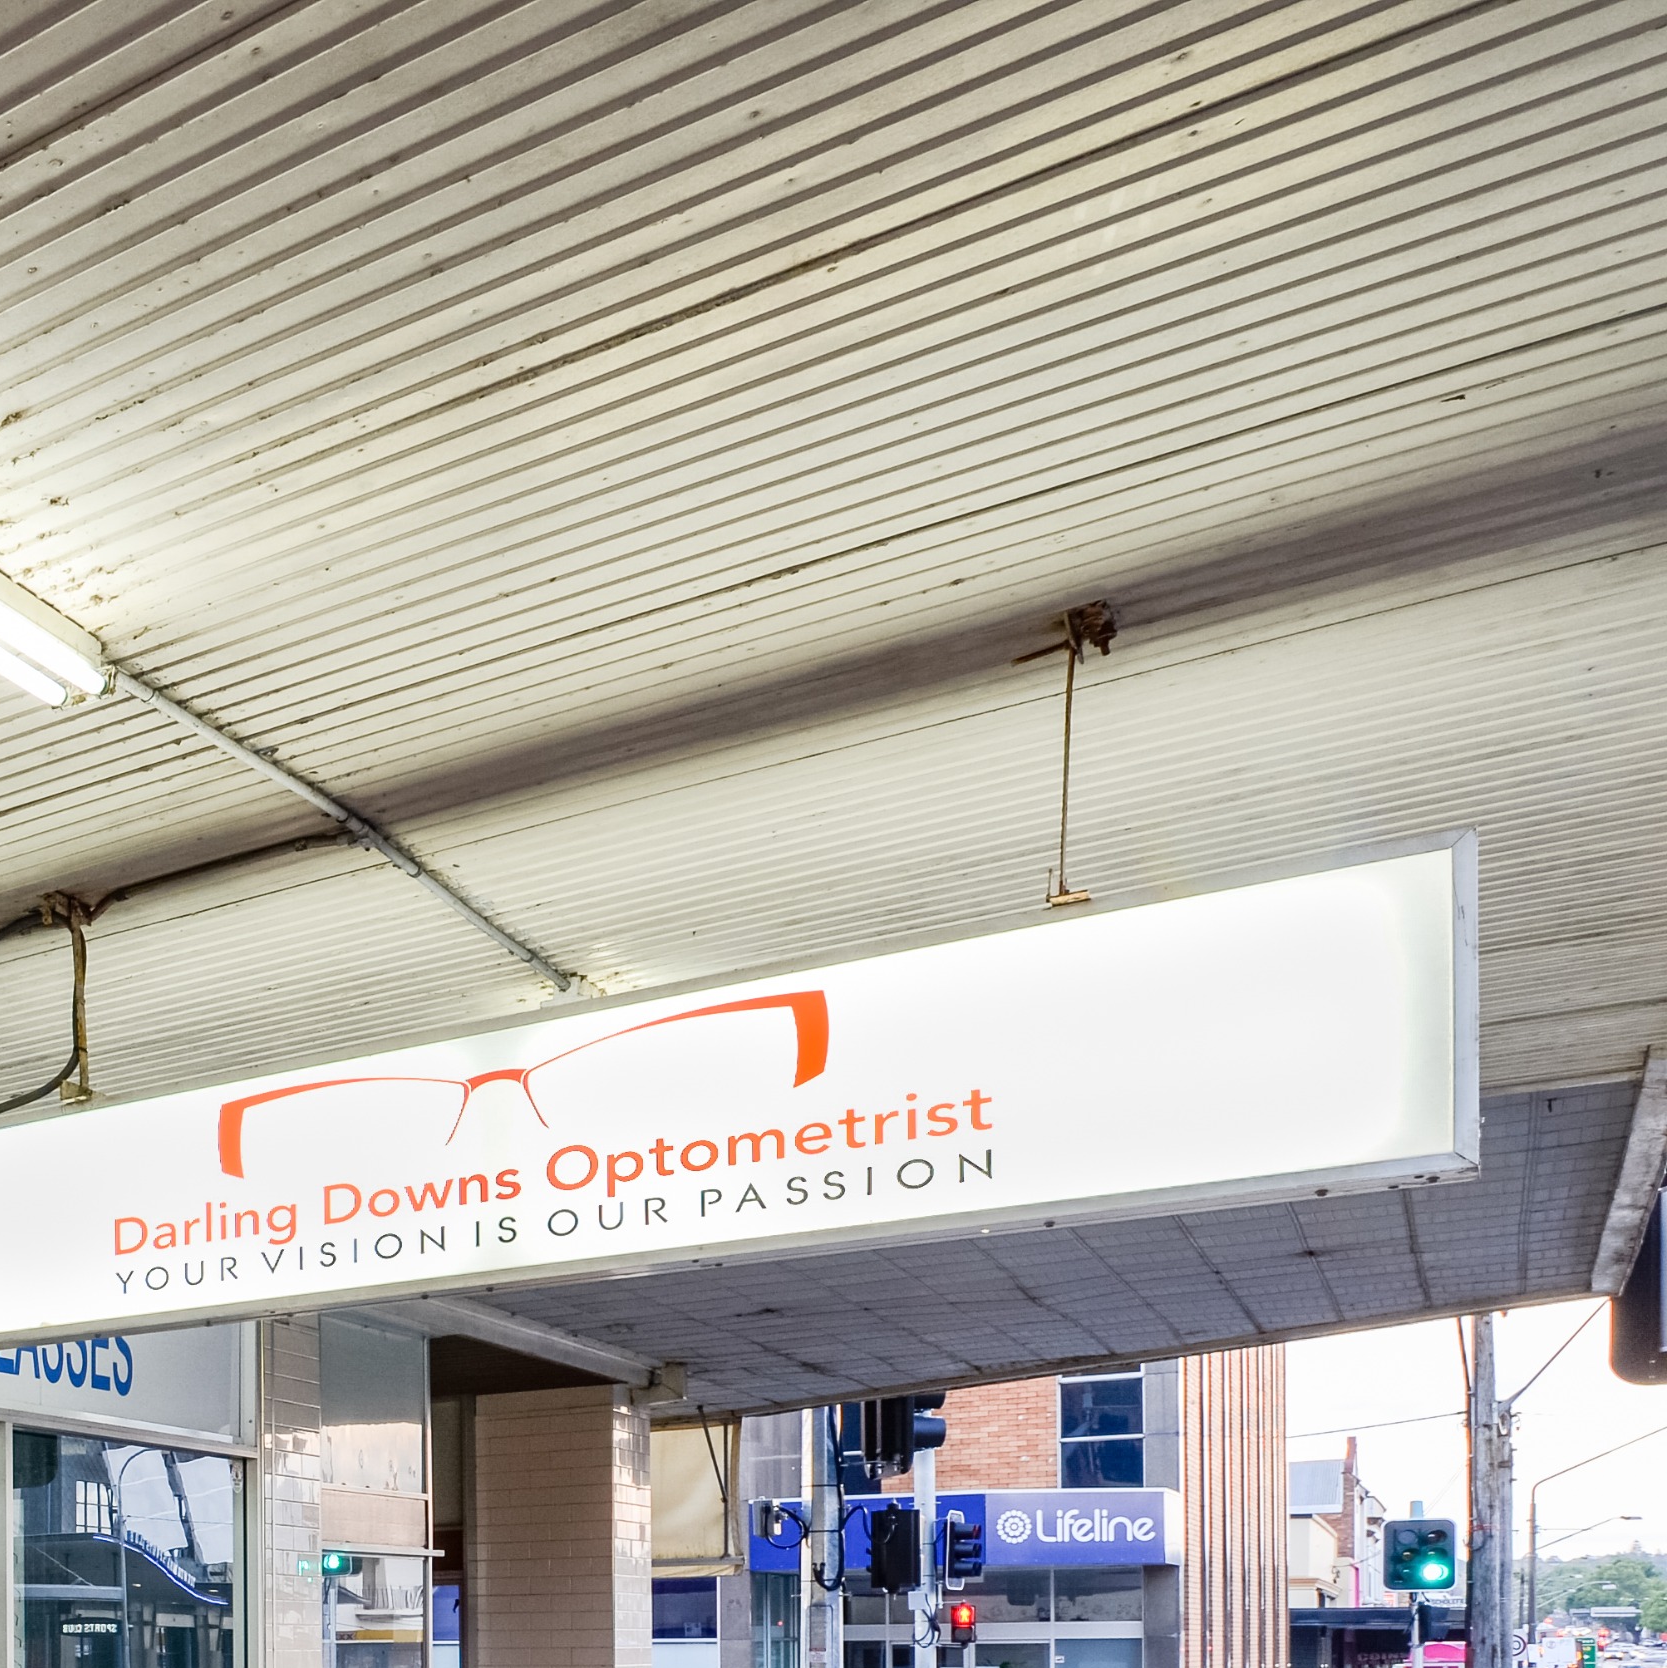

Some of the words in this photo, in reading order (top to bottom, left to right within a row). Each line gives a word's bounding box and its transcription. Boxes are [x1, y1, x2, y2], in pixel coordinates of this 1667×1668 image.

[114, 1202, 297, 1256] Darling
[323, 1168, 522, 1225] Downs
[546, 1089, 993, 1197] Optometrist
[116, 1257, 238, 1294] YOUR
[261, 1226, 446, 1274] VISION
[475, 1217, 517, 1248] IS
[547, 1197, 668, 1237] OUR
[700, 1149, 993, 1217] PASSION
[1035, 1509, 1157, 1543] Lifeline
